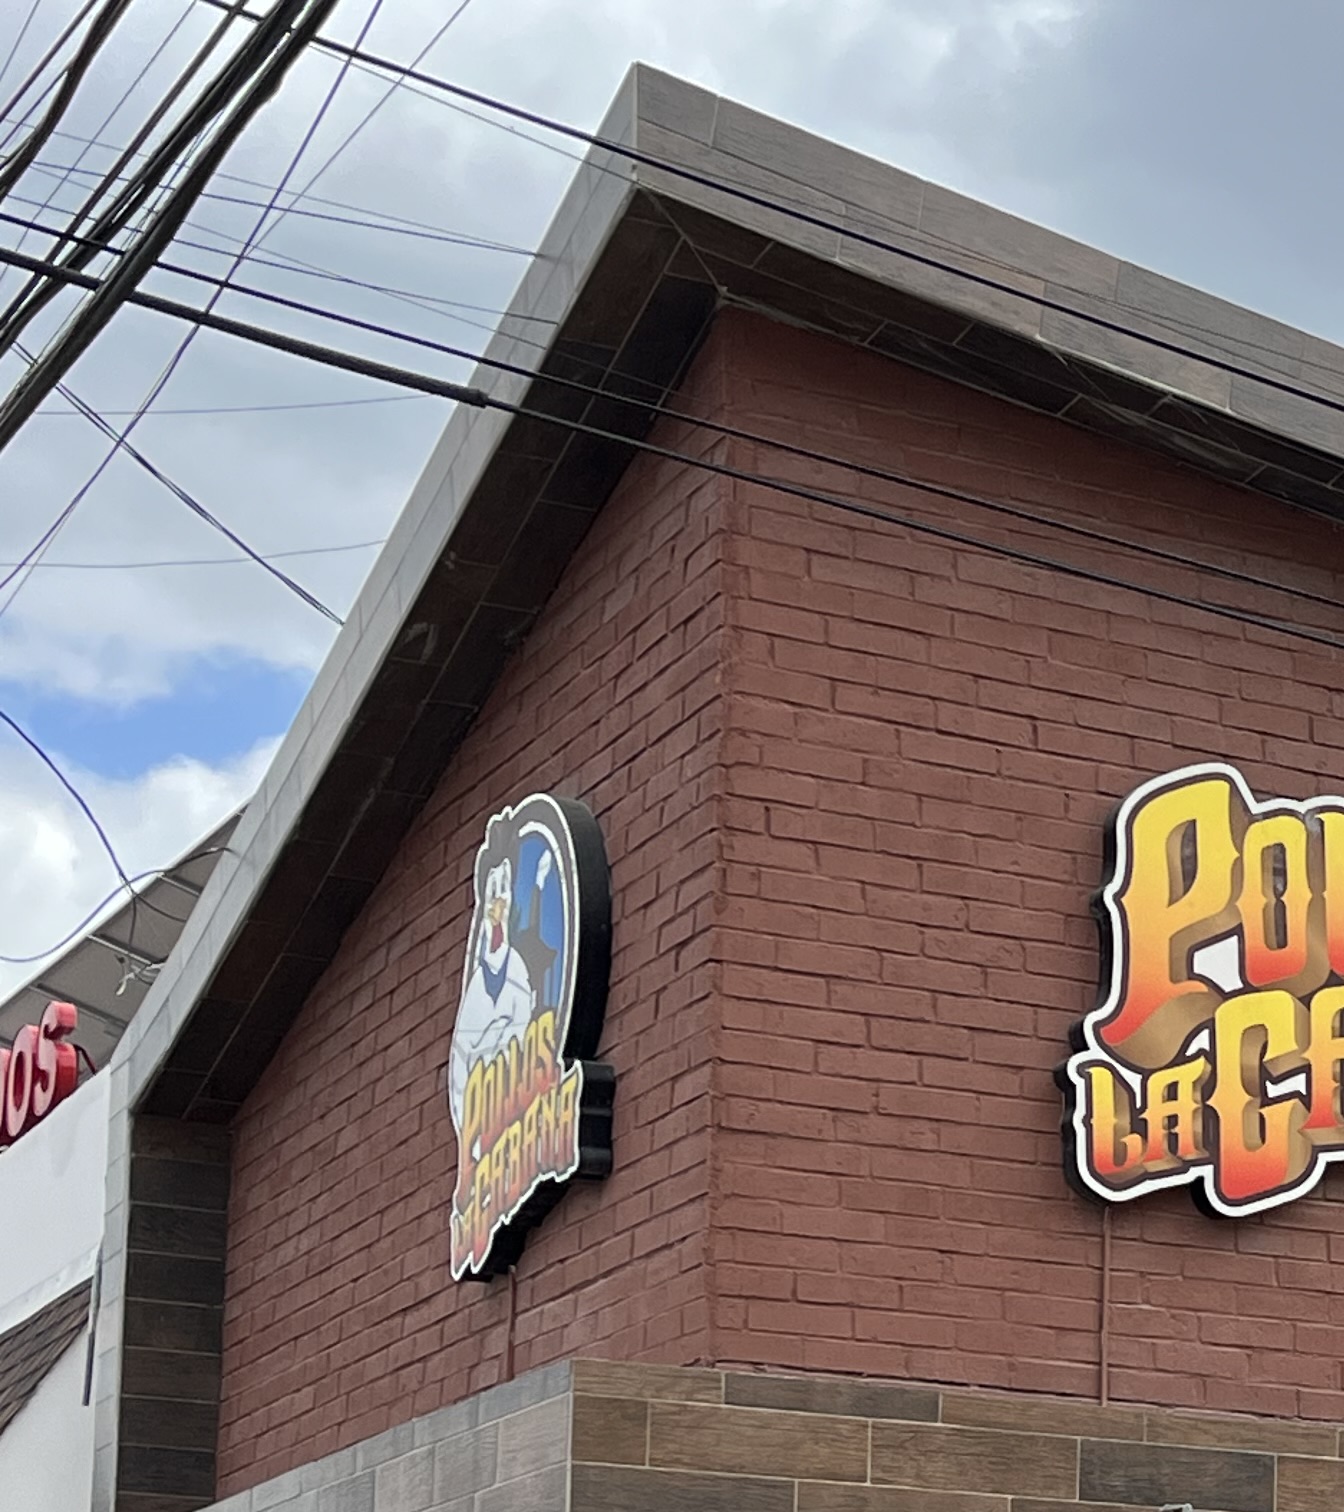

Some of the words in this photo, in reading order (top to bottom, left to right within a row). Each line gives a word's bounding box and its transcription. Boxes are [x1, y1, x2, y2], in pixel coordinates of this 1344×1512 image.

[0, 1001, 77, 1147] OS
[457, 1010, 560, 1214] POLLOS
[1078, 1058, 1210, 1183] LA
